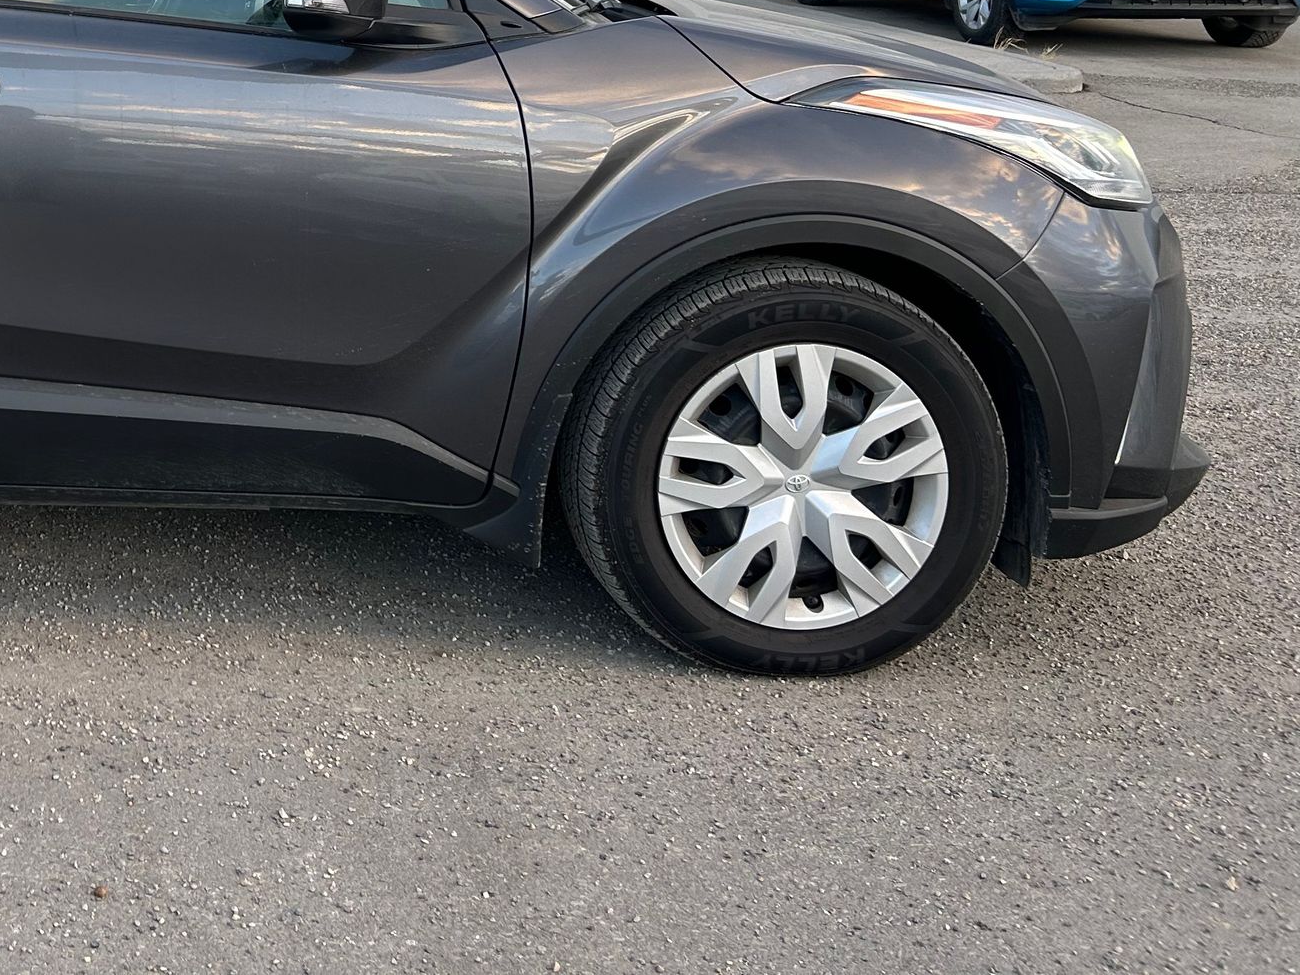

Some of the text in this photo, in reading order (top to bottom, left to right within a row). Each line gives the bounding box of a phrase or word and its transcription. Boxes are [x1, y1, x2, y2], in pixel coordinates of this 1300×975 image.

[747, 302, 861, 330] KELLY
[620, 421, 643, 503] TOURING
[623, 513, 645, 565] EDGE
[749, 647, 866, 672] KELLY
